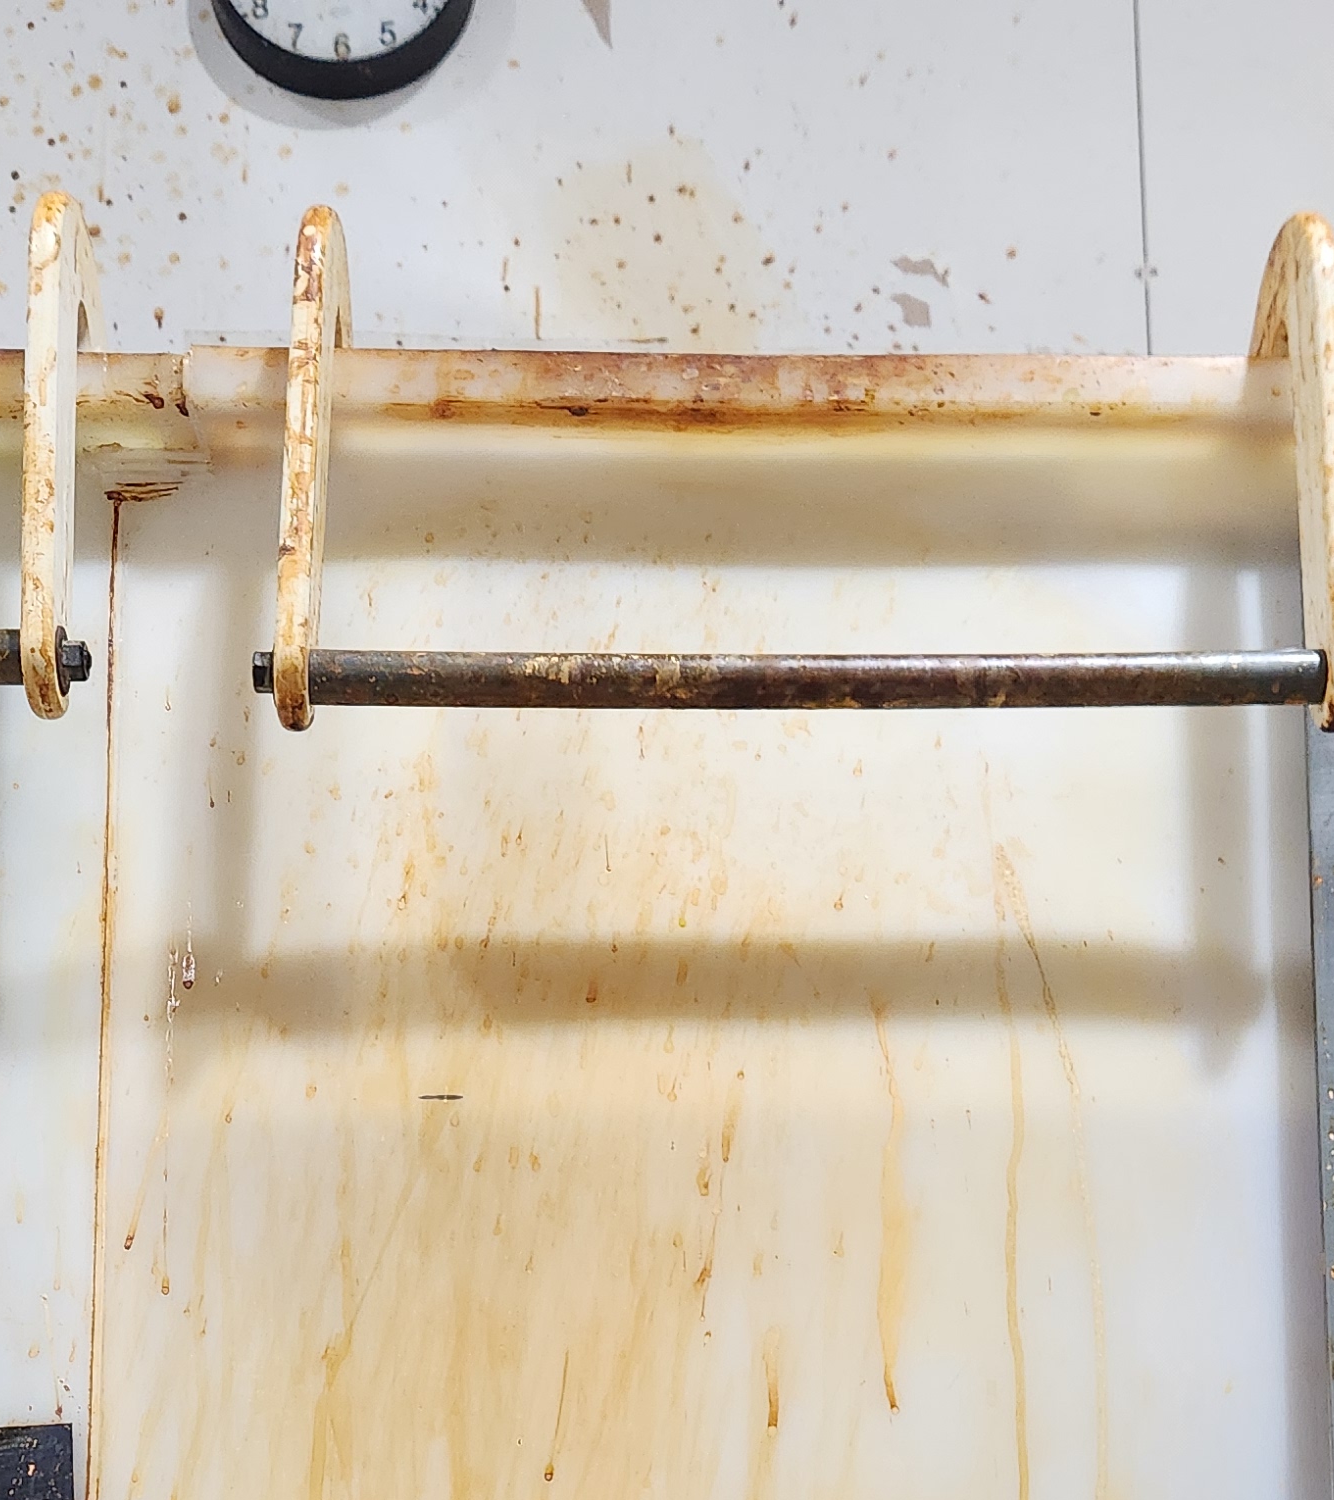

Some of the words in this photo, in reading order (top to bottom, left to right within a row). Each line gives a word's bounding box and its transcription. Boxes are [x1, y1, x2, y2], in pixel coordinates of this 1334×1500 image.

[288, 22, 303, 50] 7
[334, 32, 351, 61] 6
[379, 20, 397, 46] 5
